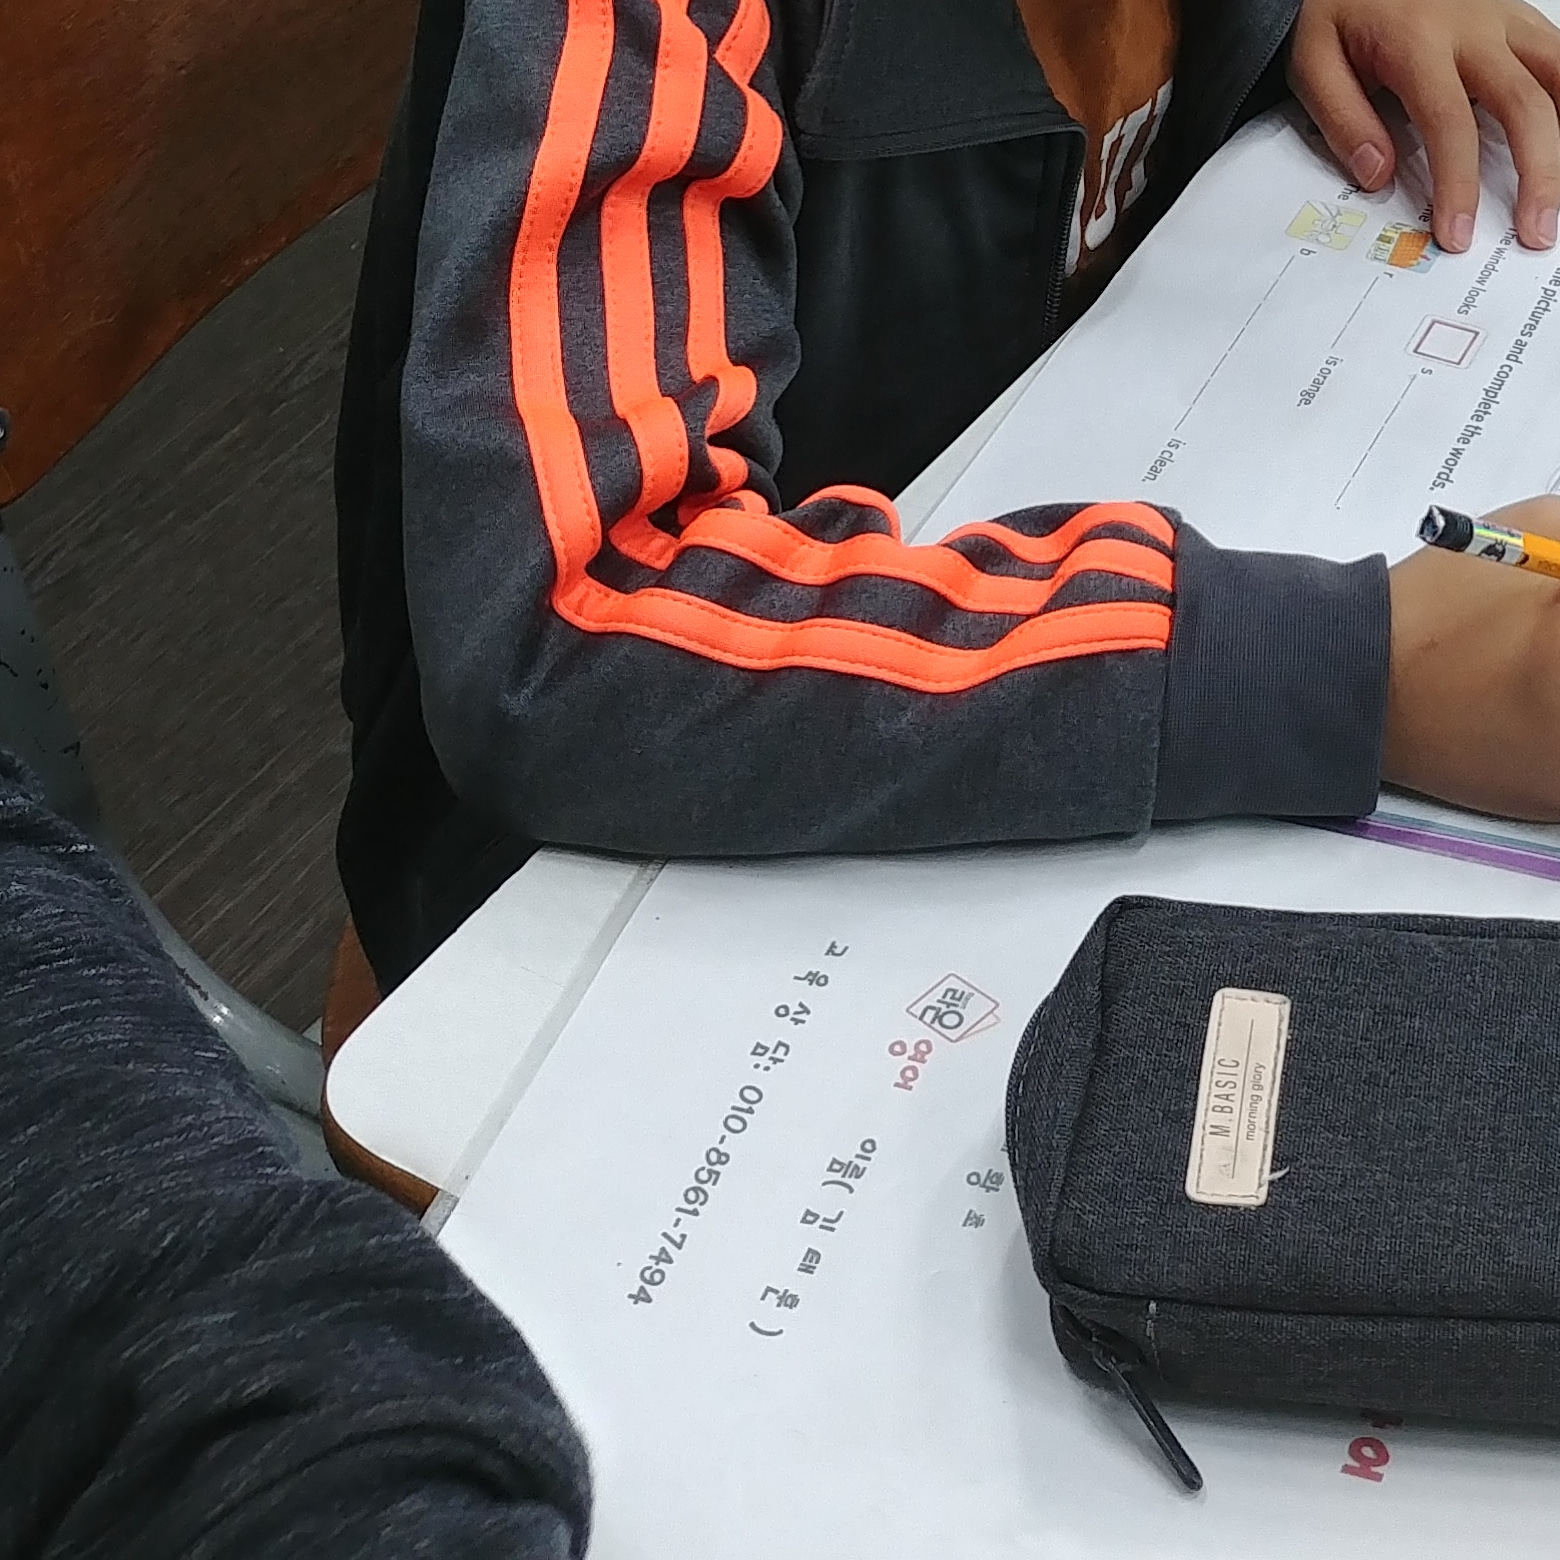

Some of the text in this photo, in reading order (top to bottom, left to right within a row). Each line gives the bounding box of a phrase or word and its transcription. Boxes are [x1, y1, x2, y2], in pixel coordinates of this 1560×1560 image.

[1300, 248, 1317, 256] b
[1383, 271, 1394, 279] r
[1457, 244, 1507, 316] window looks
[1519, 286, 1559, 337] pictures
[1506, 337, 1528, 364] and
[1296, 356, 1344, 408] is orange.
[1470, 363, 1514, 423] complete
[1457, 423, 1483, 445] the
[1141, 438, 1187, 483] is clean.
[1429, 444, 1463, 491] words.
[887, 1038, 934, 1092] 영어
[1208, 1057, 1241, 1139] M.BASIC
[1245, 1061, 1268, 1142] morning glory
[627, 940, 850, 1305] 교 육 상 담: 010-8561-7494
[800, 1207, 846, 1233] 김
[796, 1246, 823, 1276] 태
[759, 1284, 801, 1310] 훈
